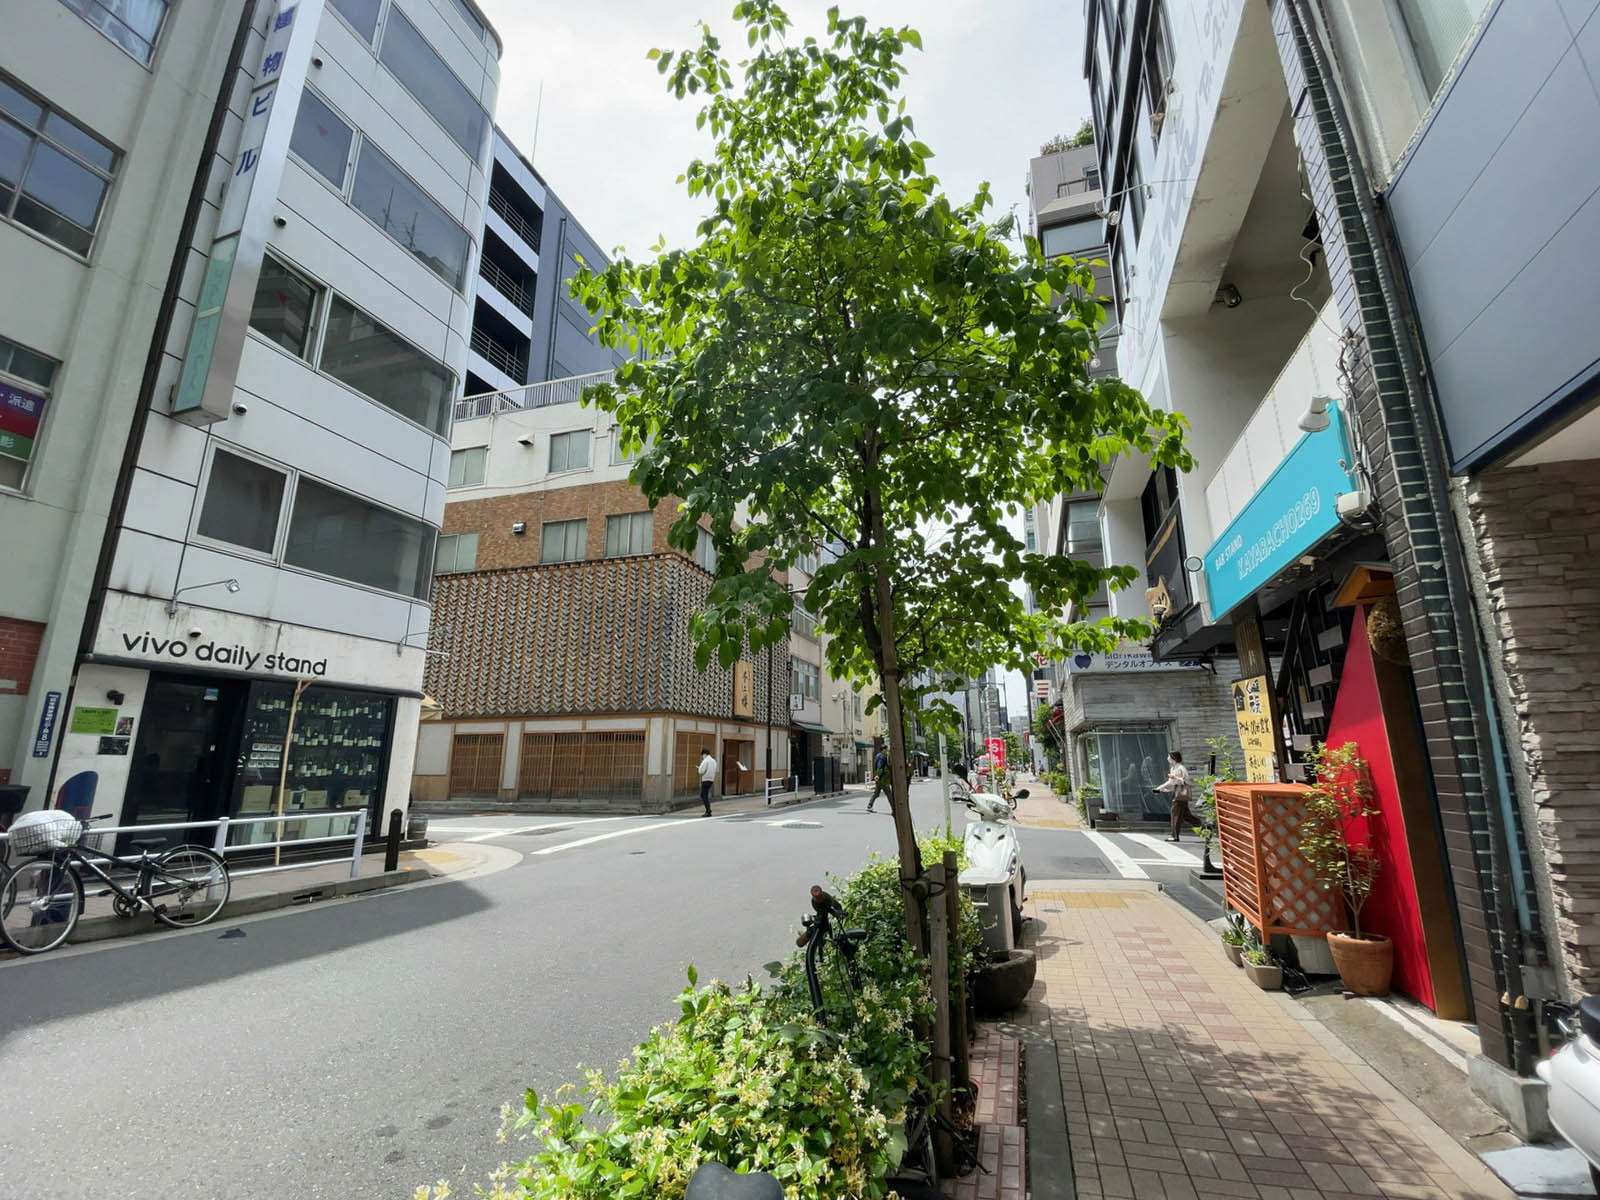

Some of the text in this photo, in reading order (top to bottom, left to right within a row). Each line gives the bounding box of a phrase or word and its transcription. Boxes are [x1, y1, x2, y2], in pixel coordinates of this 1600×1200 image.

[1236, 486, 1321, 581] KAYABACHO269
[122, 631, 328, 676] vivo daily stand
